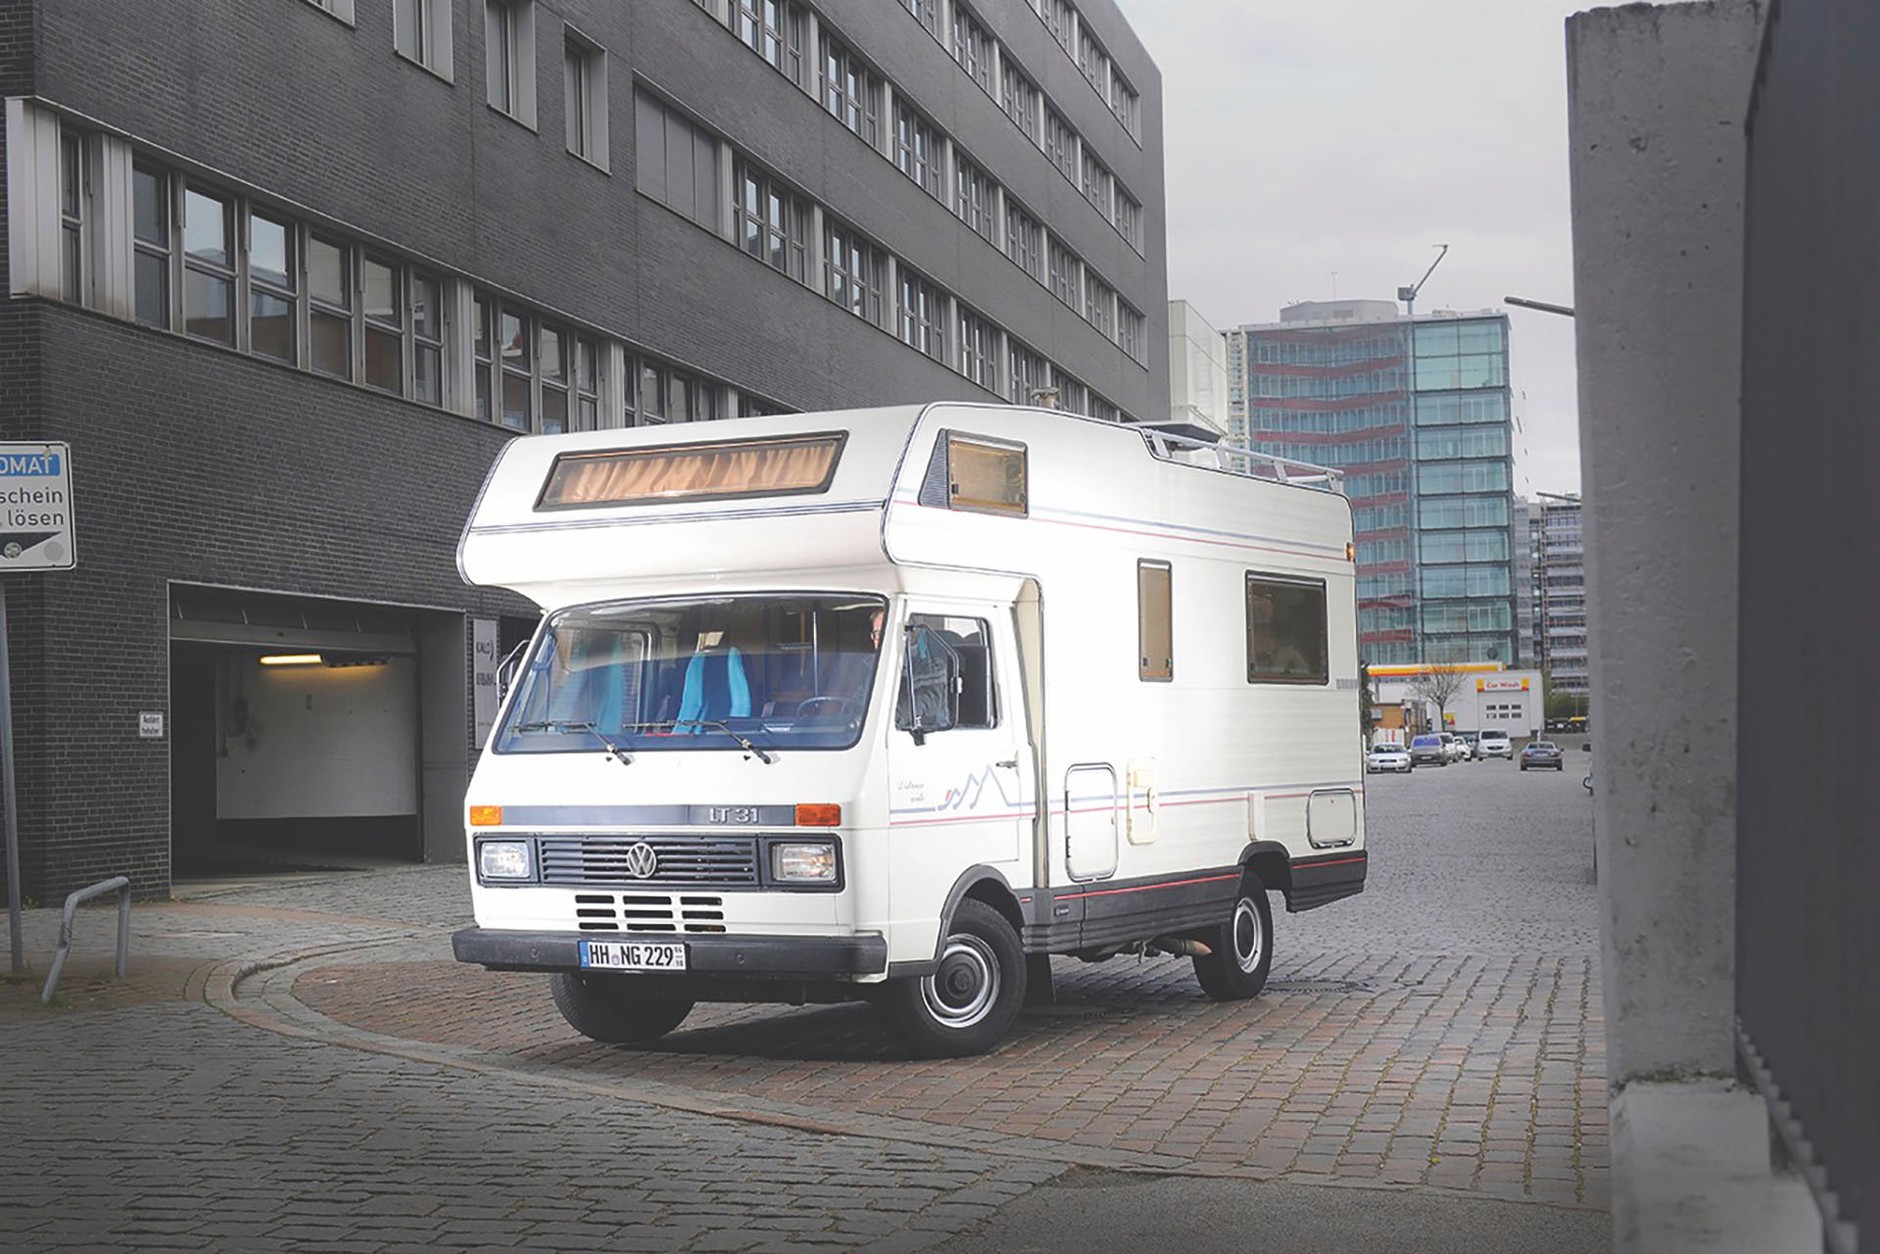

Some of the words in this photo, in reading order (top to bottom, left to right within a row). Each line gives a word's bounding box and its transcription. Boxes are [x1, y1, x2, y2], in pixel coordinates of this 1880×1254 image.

[8, 509, 64, 526] lösen
[709, 807, 731, 823] LT
[735, 807, 759, 823] 31
[589, 944, 610, 965] HH
[620, 945, 641, 966] NG
[644, 946, 674, 967] 229
